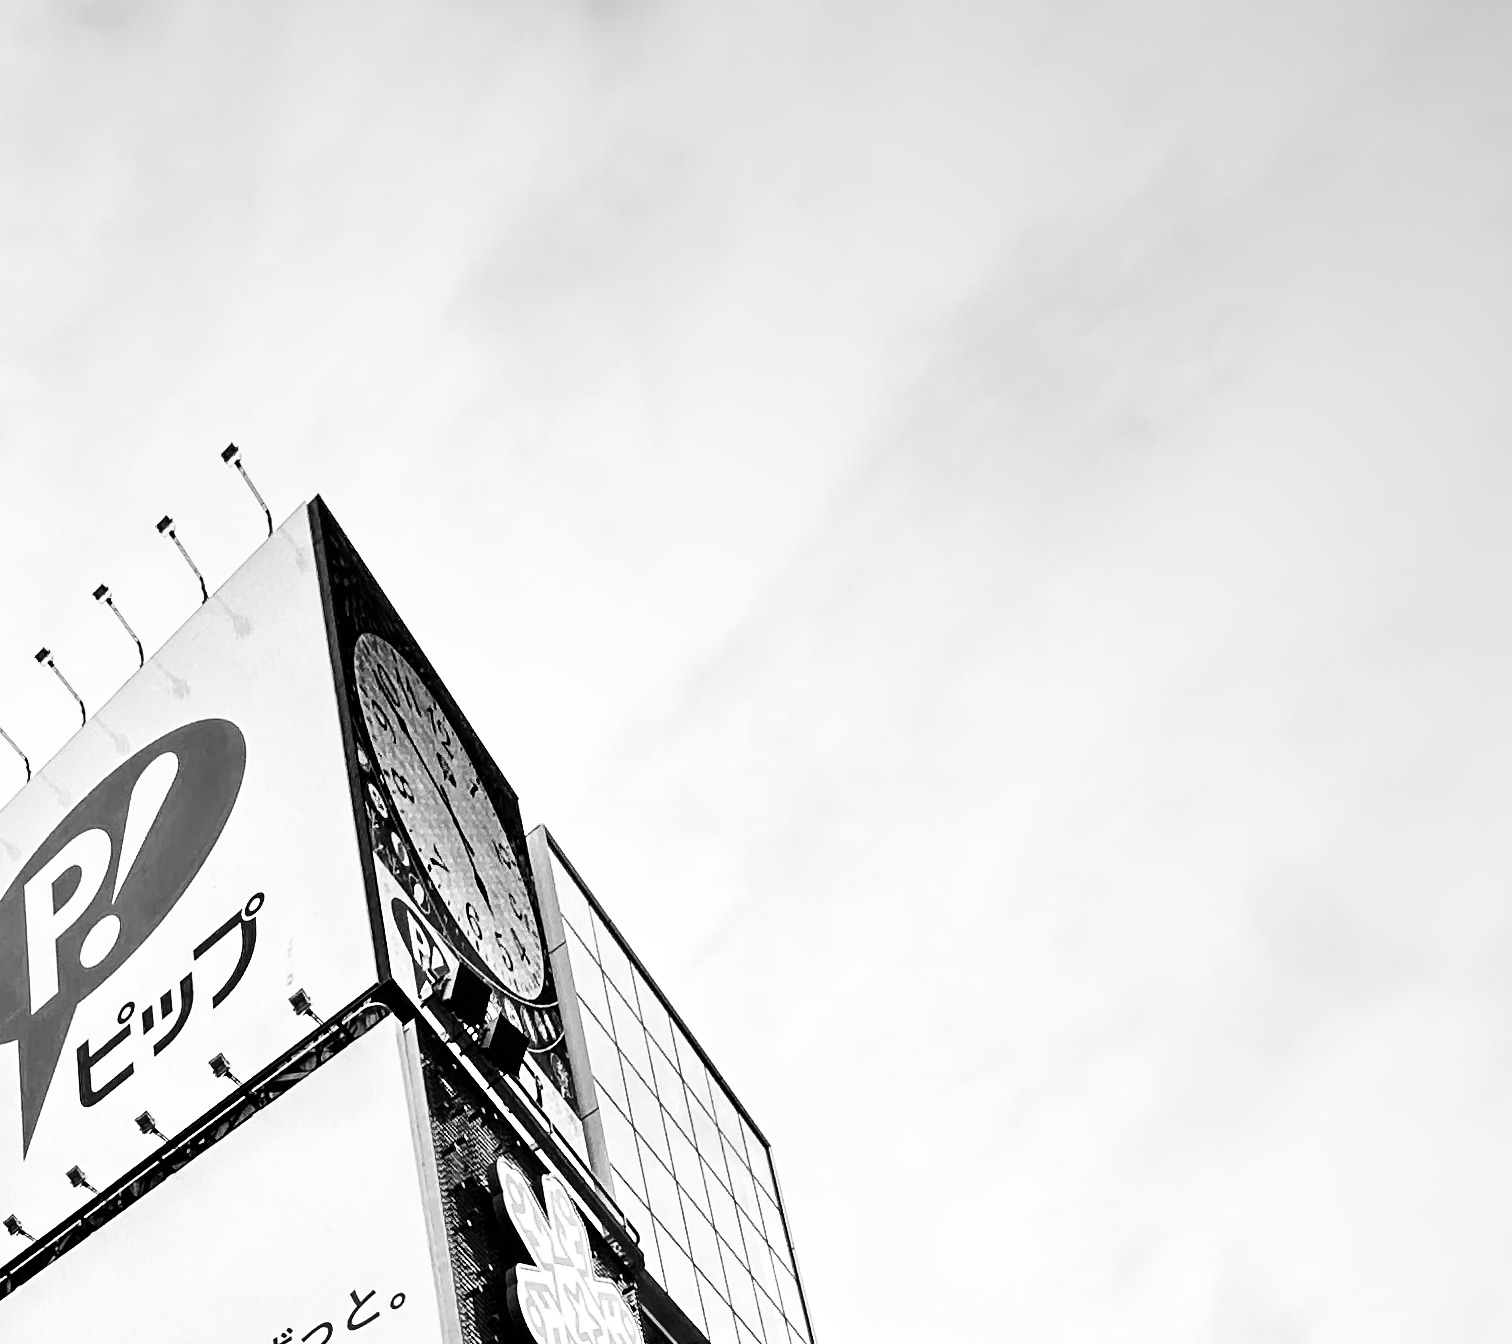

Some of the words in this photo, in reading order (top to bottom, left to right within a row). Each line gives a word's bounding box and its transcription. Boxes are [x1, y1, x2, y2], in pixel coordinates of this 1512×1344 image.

[23, 748, 180, 1017] P!
[76, 892, 266, 1109] ピップ
